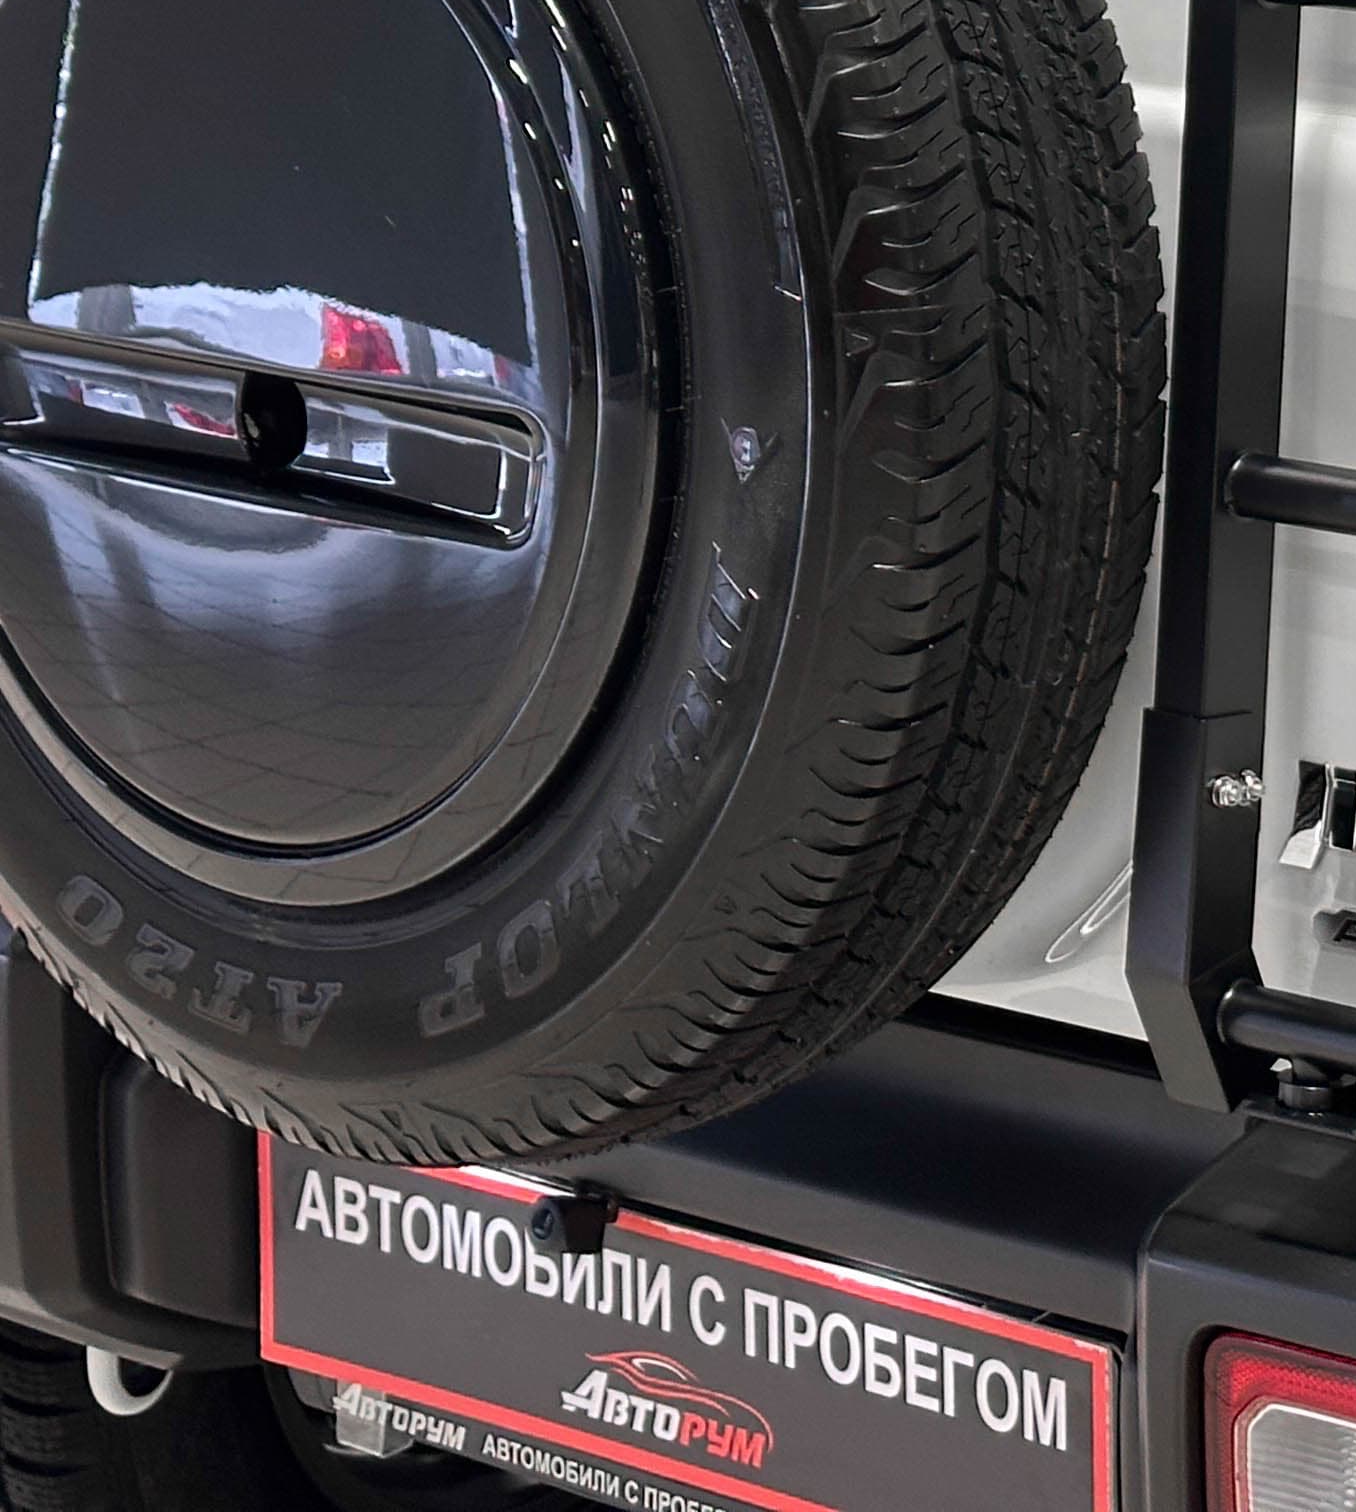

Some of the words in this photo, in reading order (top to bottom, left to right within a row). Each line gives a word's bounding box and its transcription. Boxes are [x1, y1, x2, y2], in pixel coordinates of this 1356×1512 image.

[56, 875, 344, 1047] AT20
[295, 1168, 672, 1333] АВТОМОБИЛИ
[688, 1274, 726, 1346] С
[743, 1287, 1068, 1451] ПРОБЕГОМ
[482, 1432, 620, 1498] АВТОМОБИЛИ
[624, 1479, 639, 1504] С
